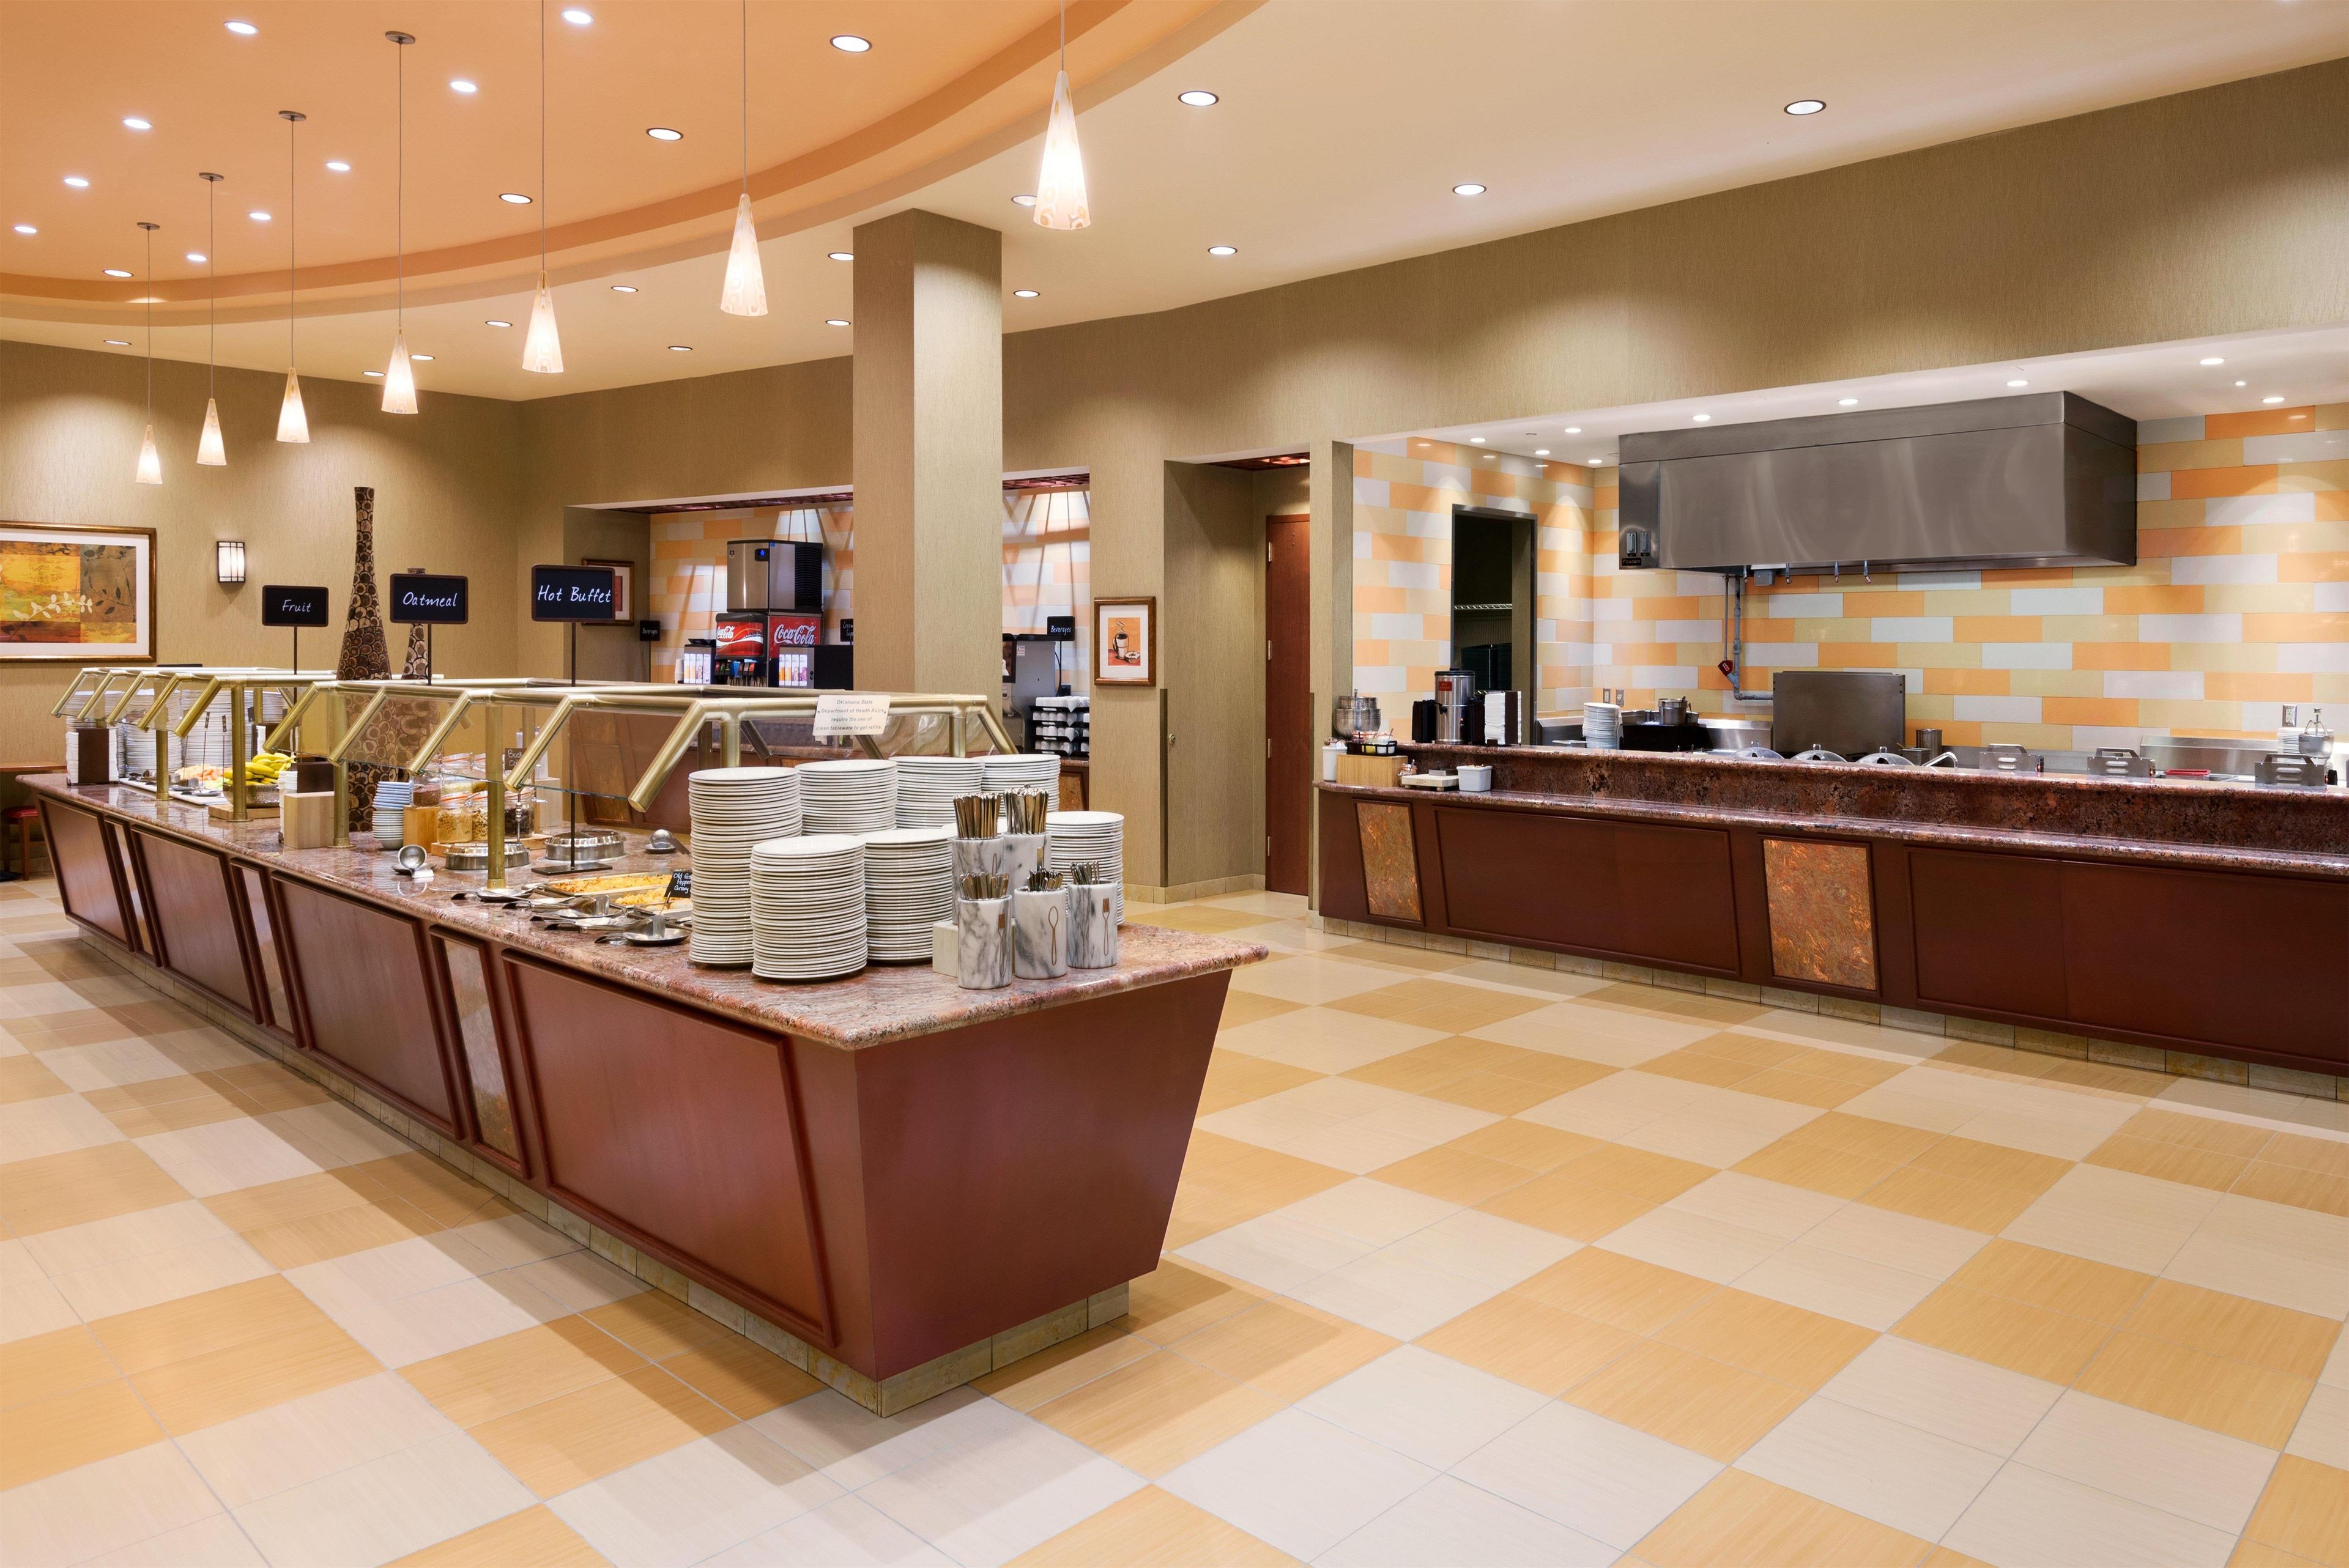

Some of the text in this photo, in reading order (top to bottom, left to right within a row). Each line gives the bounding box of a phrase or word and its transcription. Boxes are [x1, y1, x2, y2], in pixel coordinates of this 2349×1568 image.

[403, 591, 458, 607] Oatmeal
[538, 585, 611, 603] Hot Buffet
[282, 599, 311, 612] Fruit
[774, 624, 816, 645] Coca-Cola
[1050, 625, 1072, 635] Beverages
